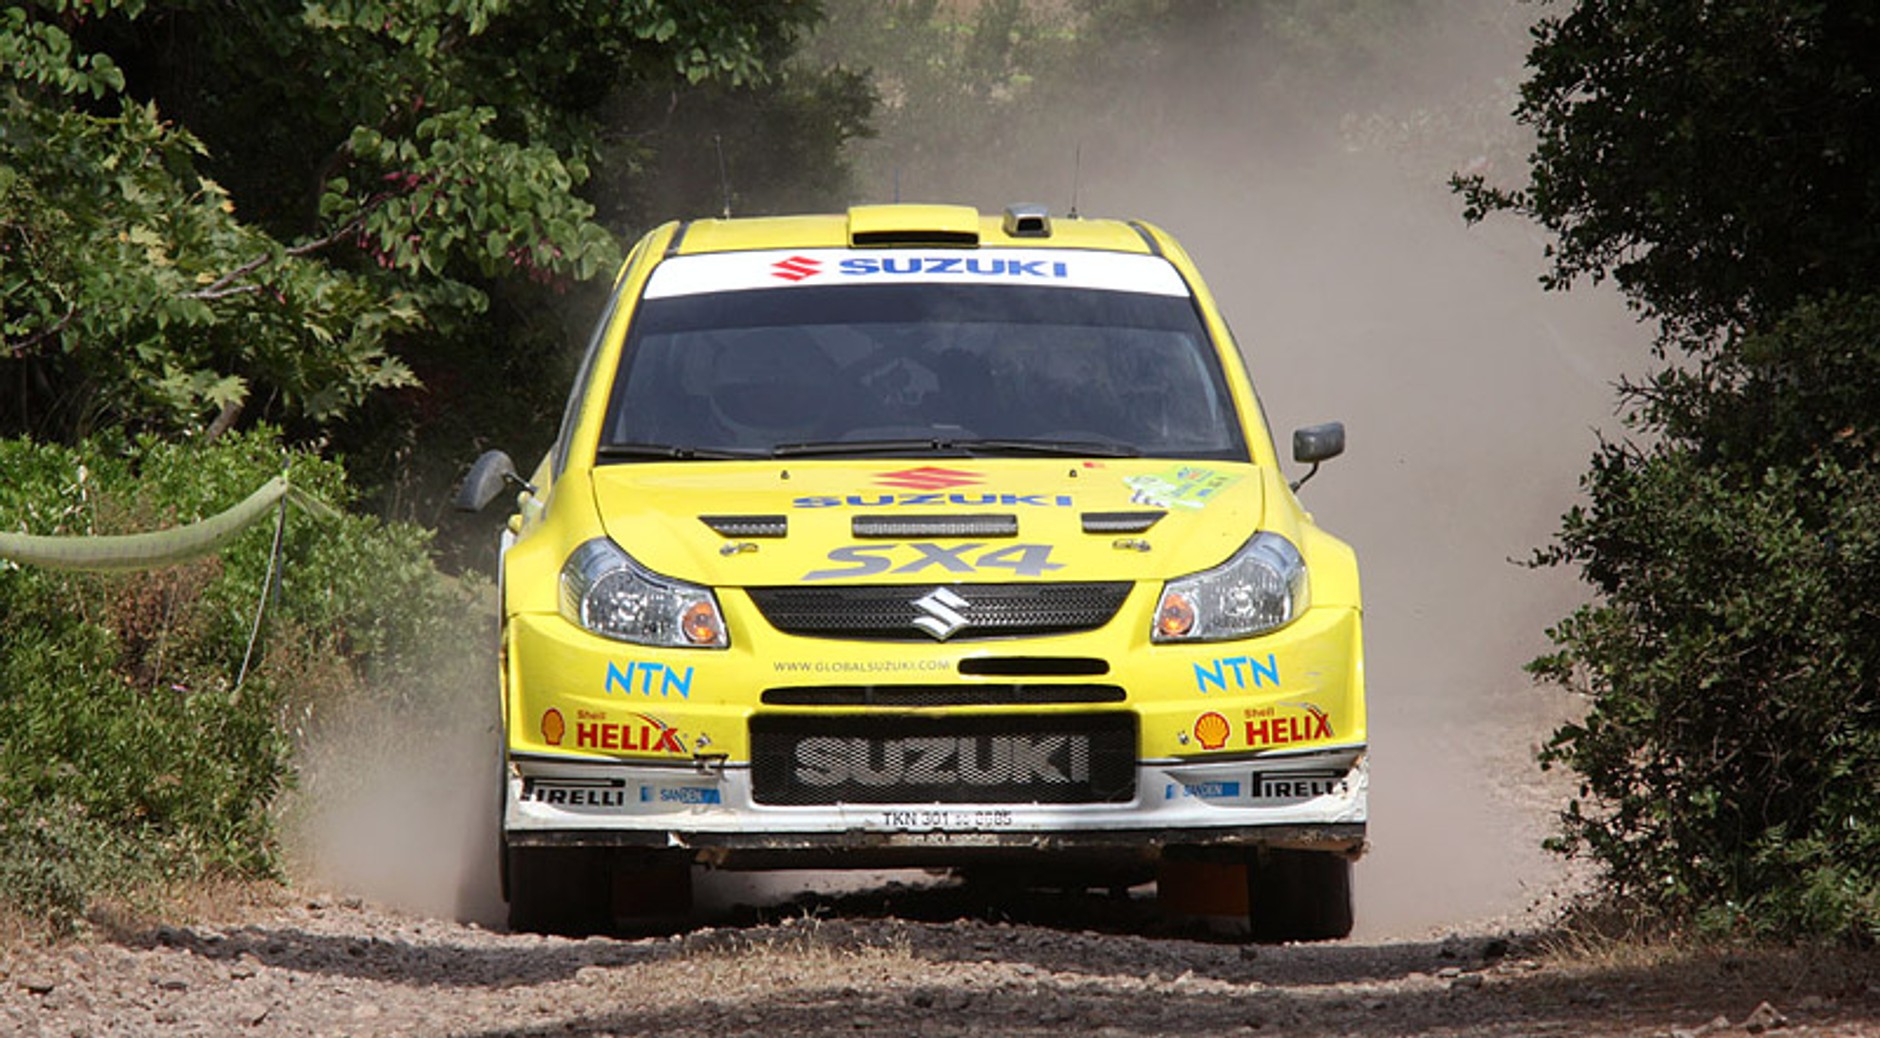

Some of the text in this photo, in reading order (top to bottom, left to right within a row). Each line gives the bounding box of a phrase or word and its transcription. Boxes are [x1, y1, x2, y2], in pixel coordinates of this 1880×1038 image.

[838, 257, 1068, 278] SUZUKI
[793, 493, 1073, 508] SUZUKI
[801, 543, 1067, 581] SX4
[604, 661, 694, 699] NTN
[1193, 653, 1280, 694] NTN
[577, 709, 606, 720] Shell
[1244, 707, 1275, 719] Shell
[1245, 706, 1335, 746] HELIX
[576, 714, 688, 753] HELIX
[795, 736, 1090, 786] SUZUKI
